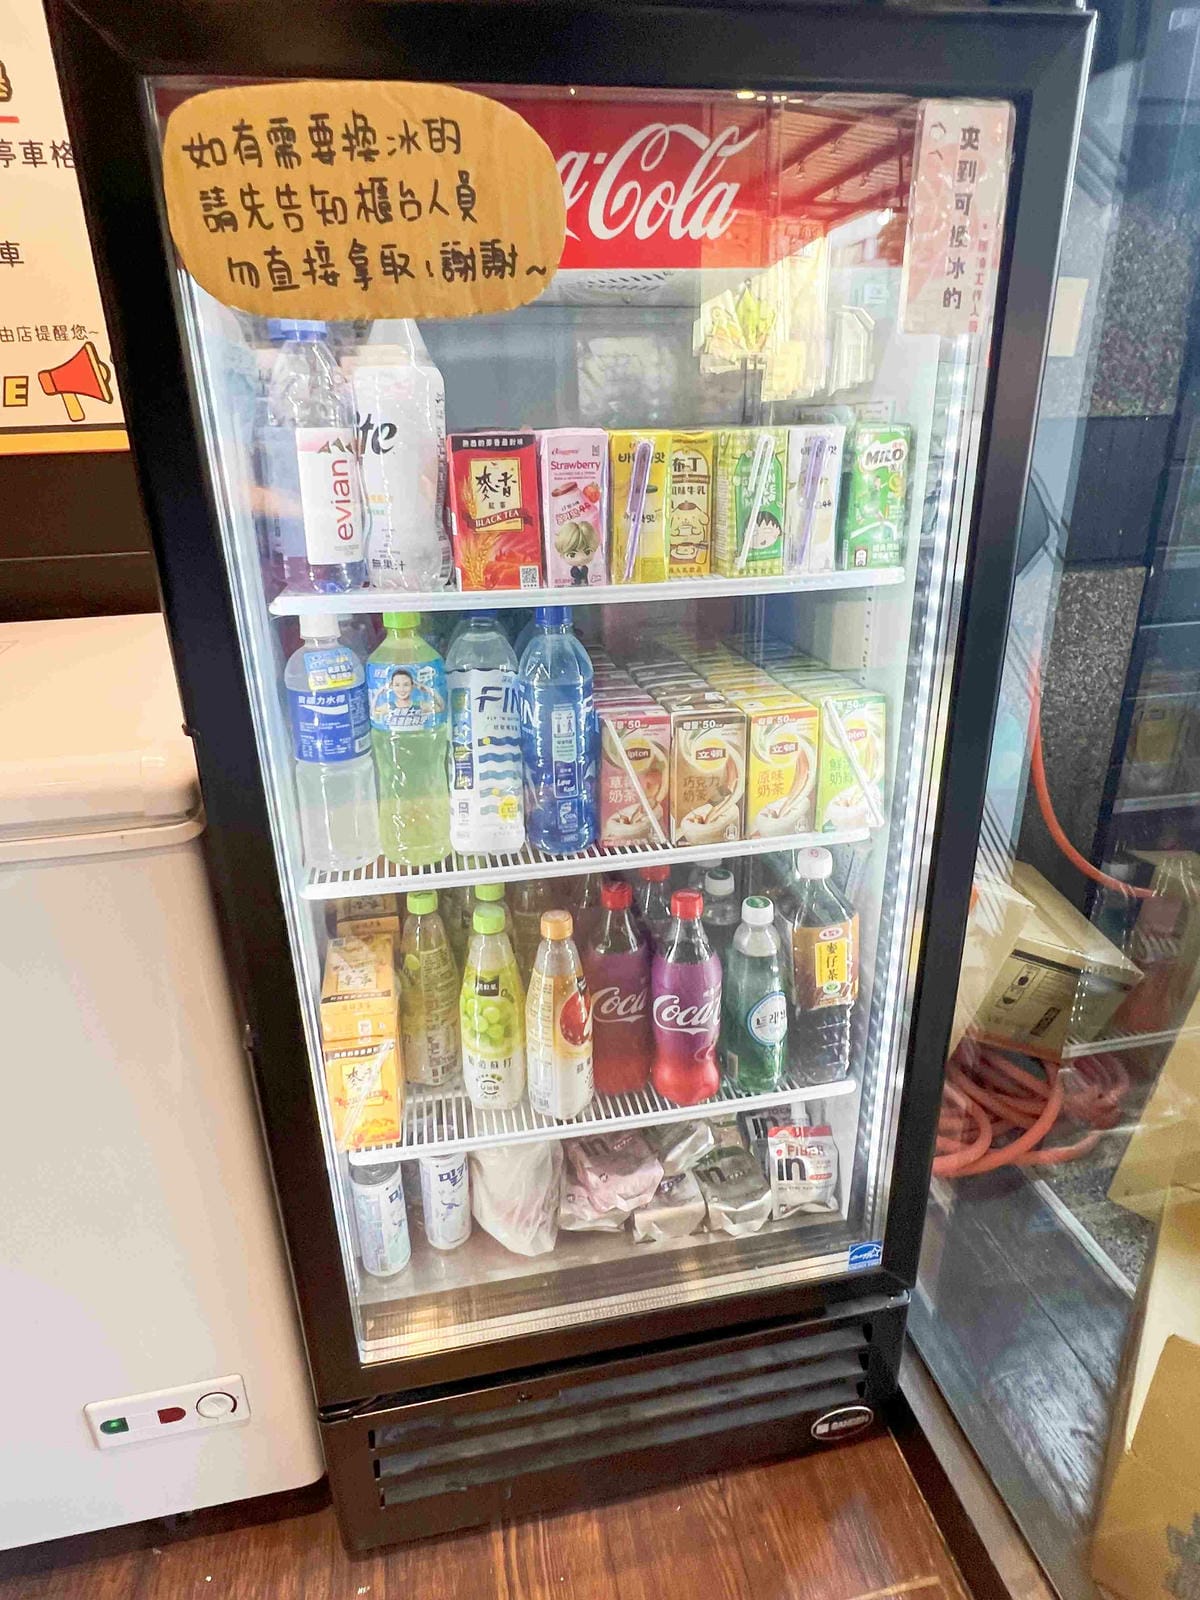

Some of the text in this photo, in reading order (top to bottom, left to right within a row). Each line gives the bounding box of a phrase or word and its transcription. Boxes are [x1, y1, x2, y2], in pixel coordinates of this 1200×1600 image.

[200, 170, 477, 234] 請先告知櫃台人員
[551, 460, 601, 471] Strawberry
[865, 448, 904, 466] MILO
[331, 458, 354, 541] evian
[475, 509, 520, 527] BLACK TEA
[777, 1158, 807, 1181] in
